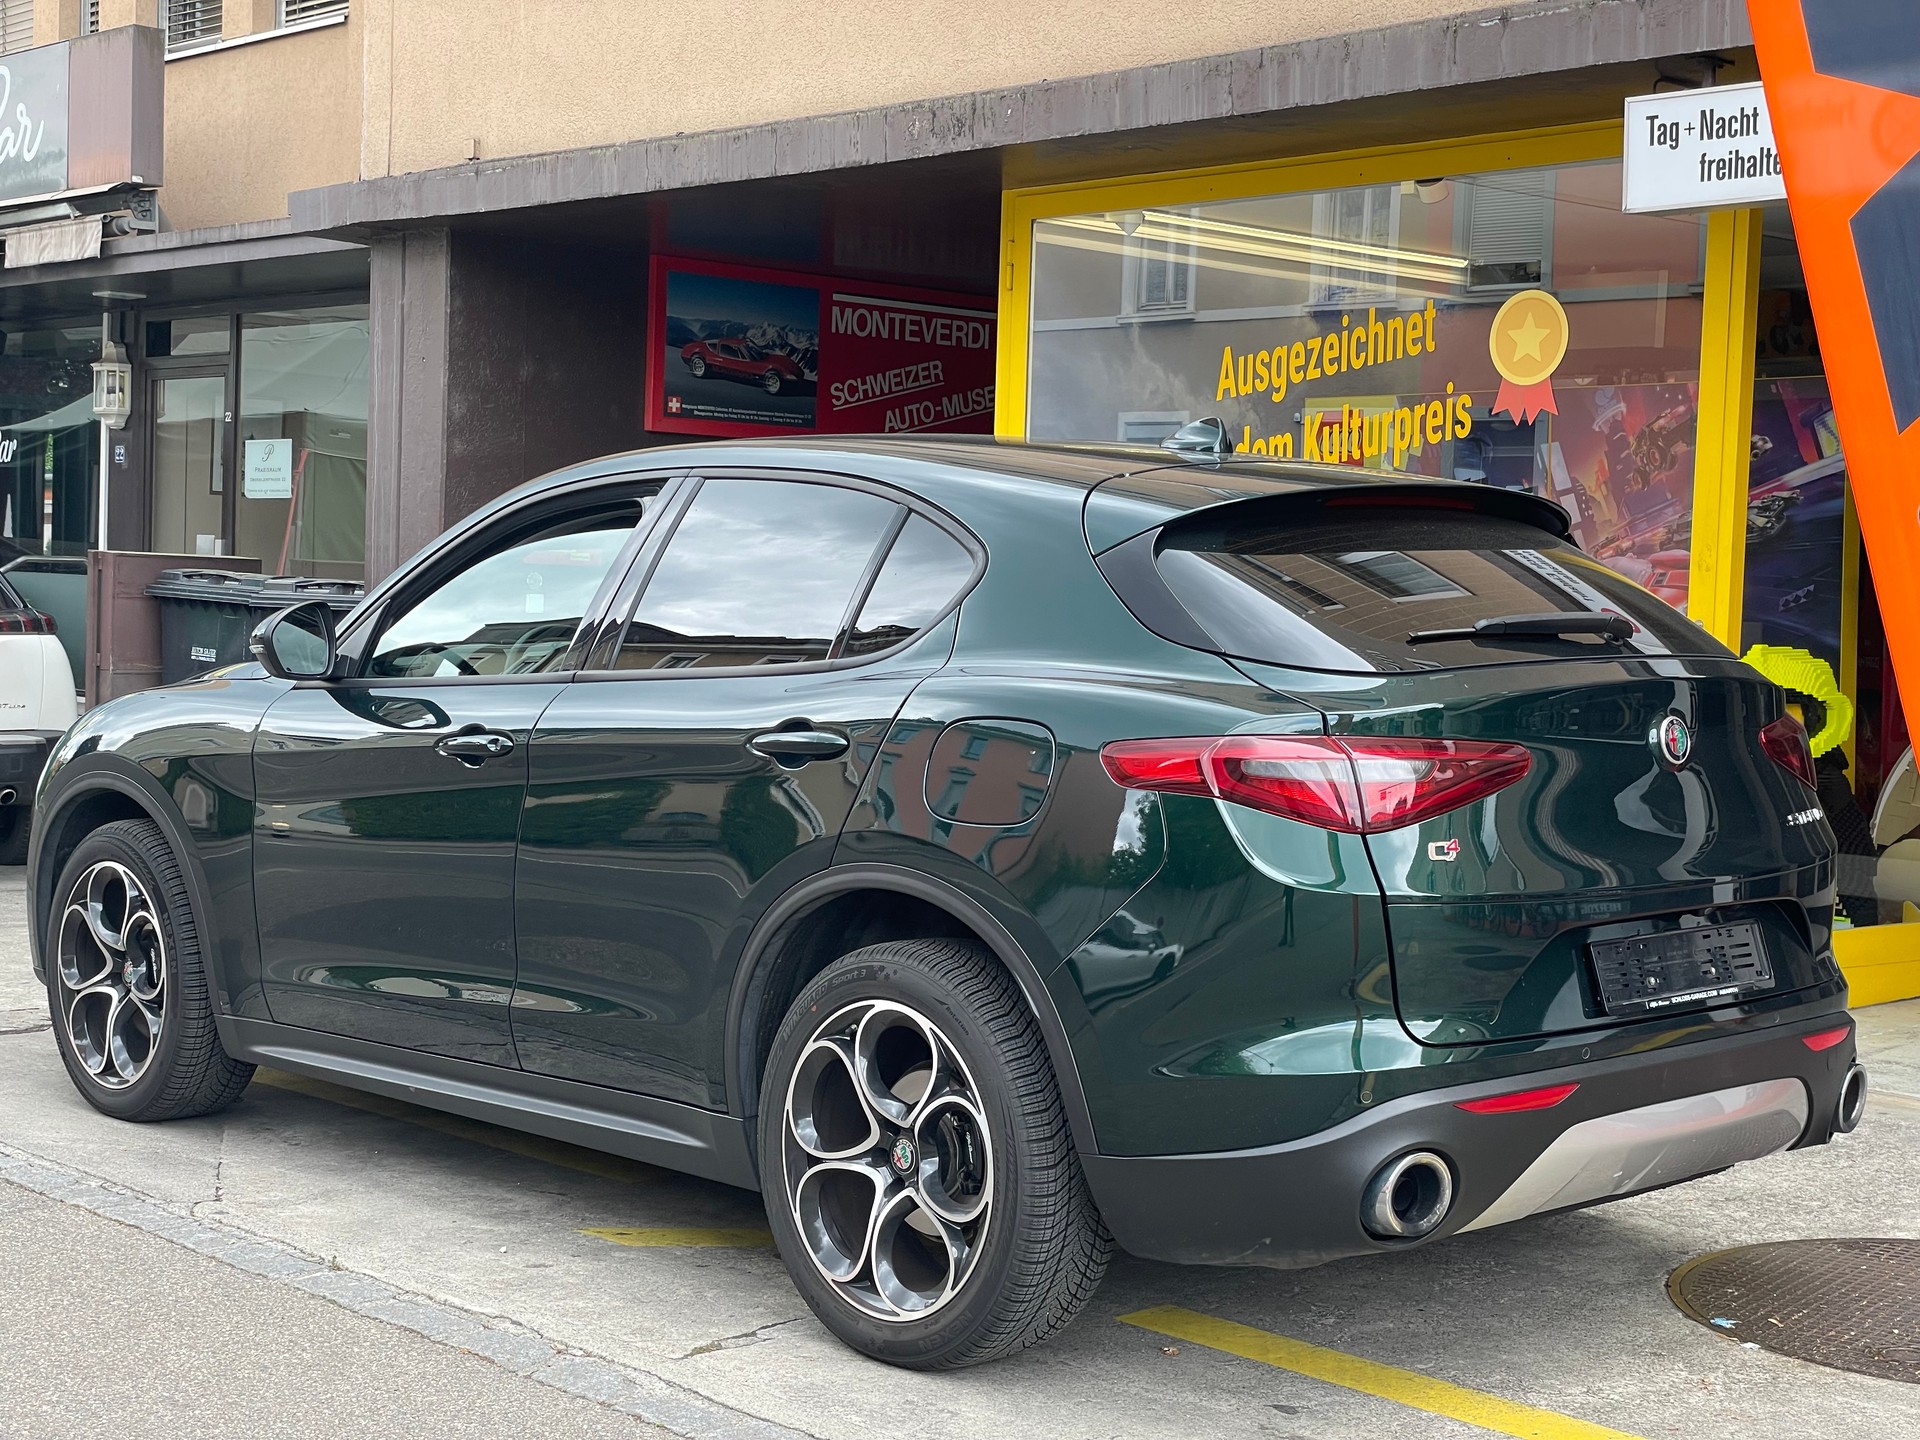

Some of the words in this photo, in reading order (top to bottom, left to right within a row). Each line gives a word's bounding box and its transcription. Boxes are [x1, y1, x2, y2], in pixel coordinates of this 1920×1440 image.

[1645, 114, 1680, 150] Tag
[1699, 106, 1760, 142] Nacht
[831, 305, 990, 350] MONTEVERDI
[1215, 298, 1437, 403] Ausgezeichnet
[830, 359, 945, 406] SCHWEIZER
[1303, 381, 1473, 468] Kulturpreis
[832, 970, 859, 988] Sport
